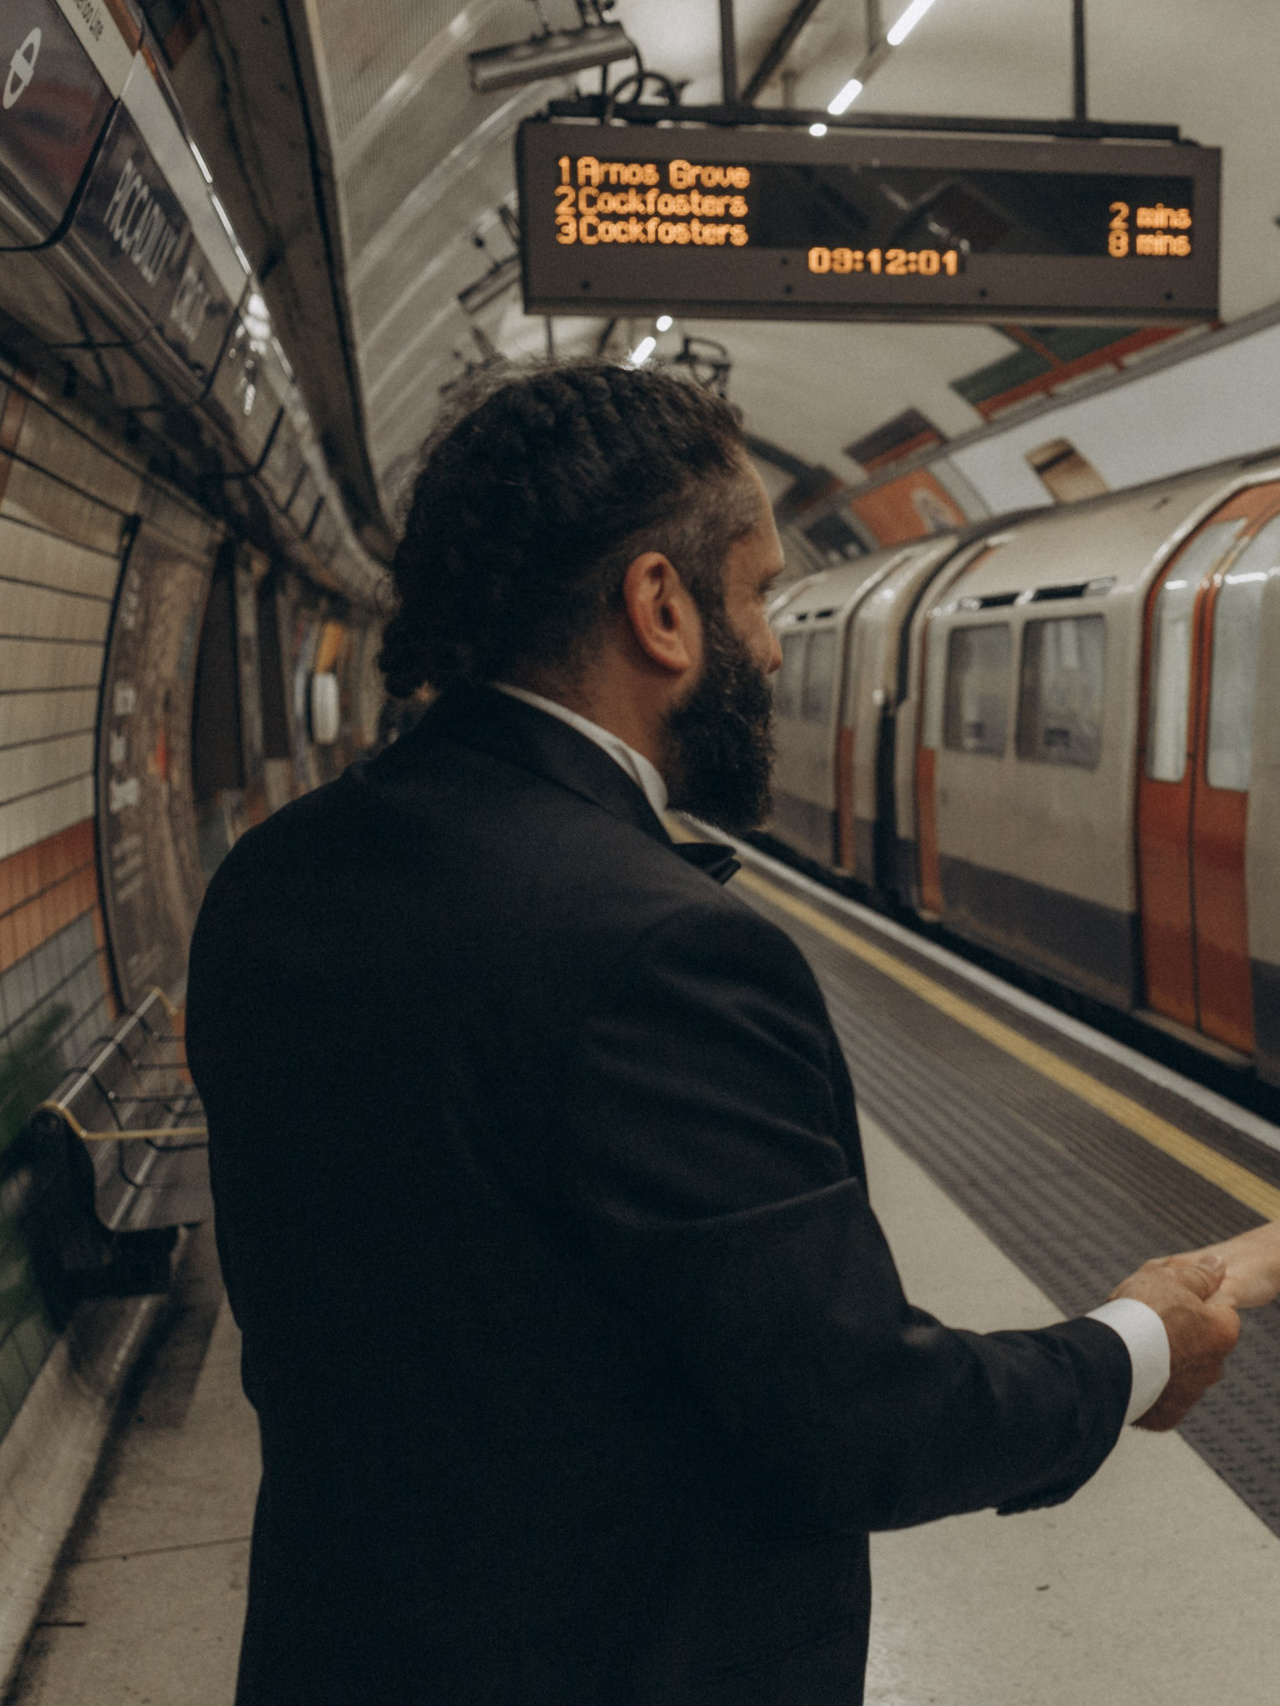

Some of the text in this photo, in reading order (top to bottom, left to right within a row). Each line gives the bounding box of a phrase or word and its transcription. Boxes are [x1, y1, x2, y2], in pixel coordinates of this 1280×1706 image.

[577, 156, 660, 187] Arnos
[669, 159, 750, 190] Grove
[1108, 201, 1130, 230] 2
[1136, 203, 1192, 229] mins
[1108, 229, 1130, 257] 8
[1135, 230, 1192, 257] mins
